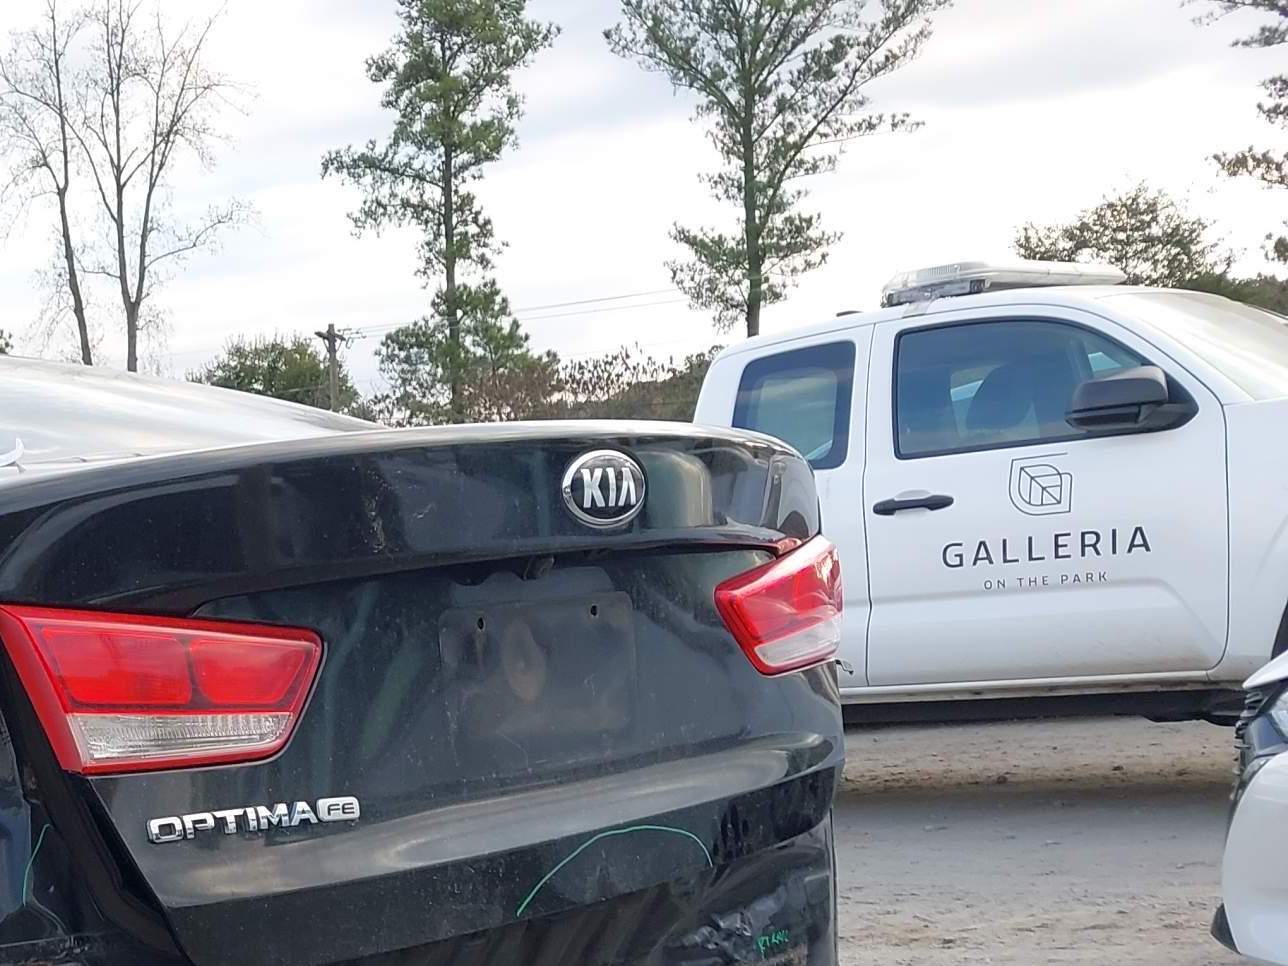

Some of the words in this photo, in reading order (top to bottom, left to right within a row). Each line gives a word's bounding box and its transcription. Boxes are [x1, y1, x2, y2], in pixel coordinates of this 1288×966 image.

[579, 466, 637, 509] KIA
[941, 525, 1152, 569] GALLERIA
[983, 578, 1007, 591] ON
[1016, 575, 1050, 588] THE
[1060, 570, 1109, 585] PARK
[147, 800, 319, 844] OPTIMA
